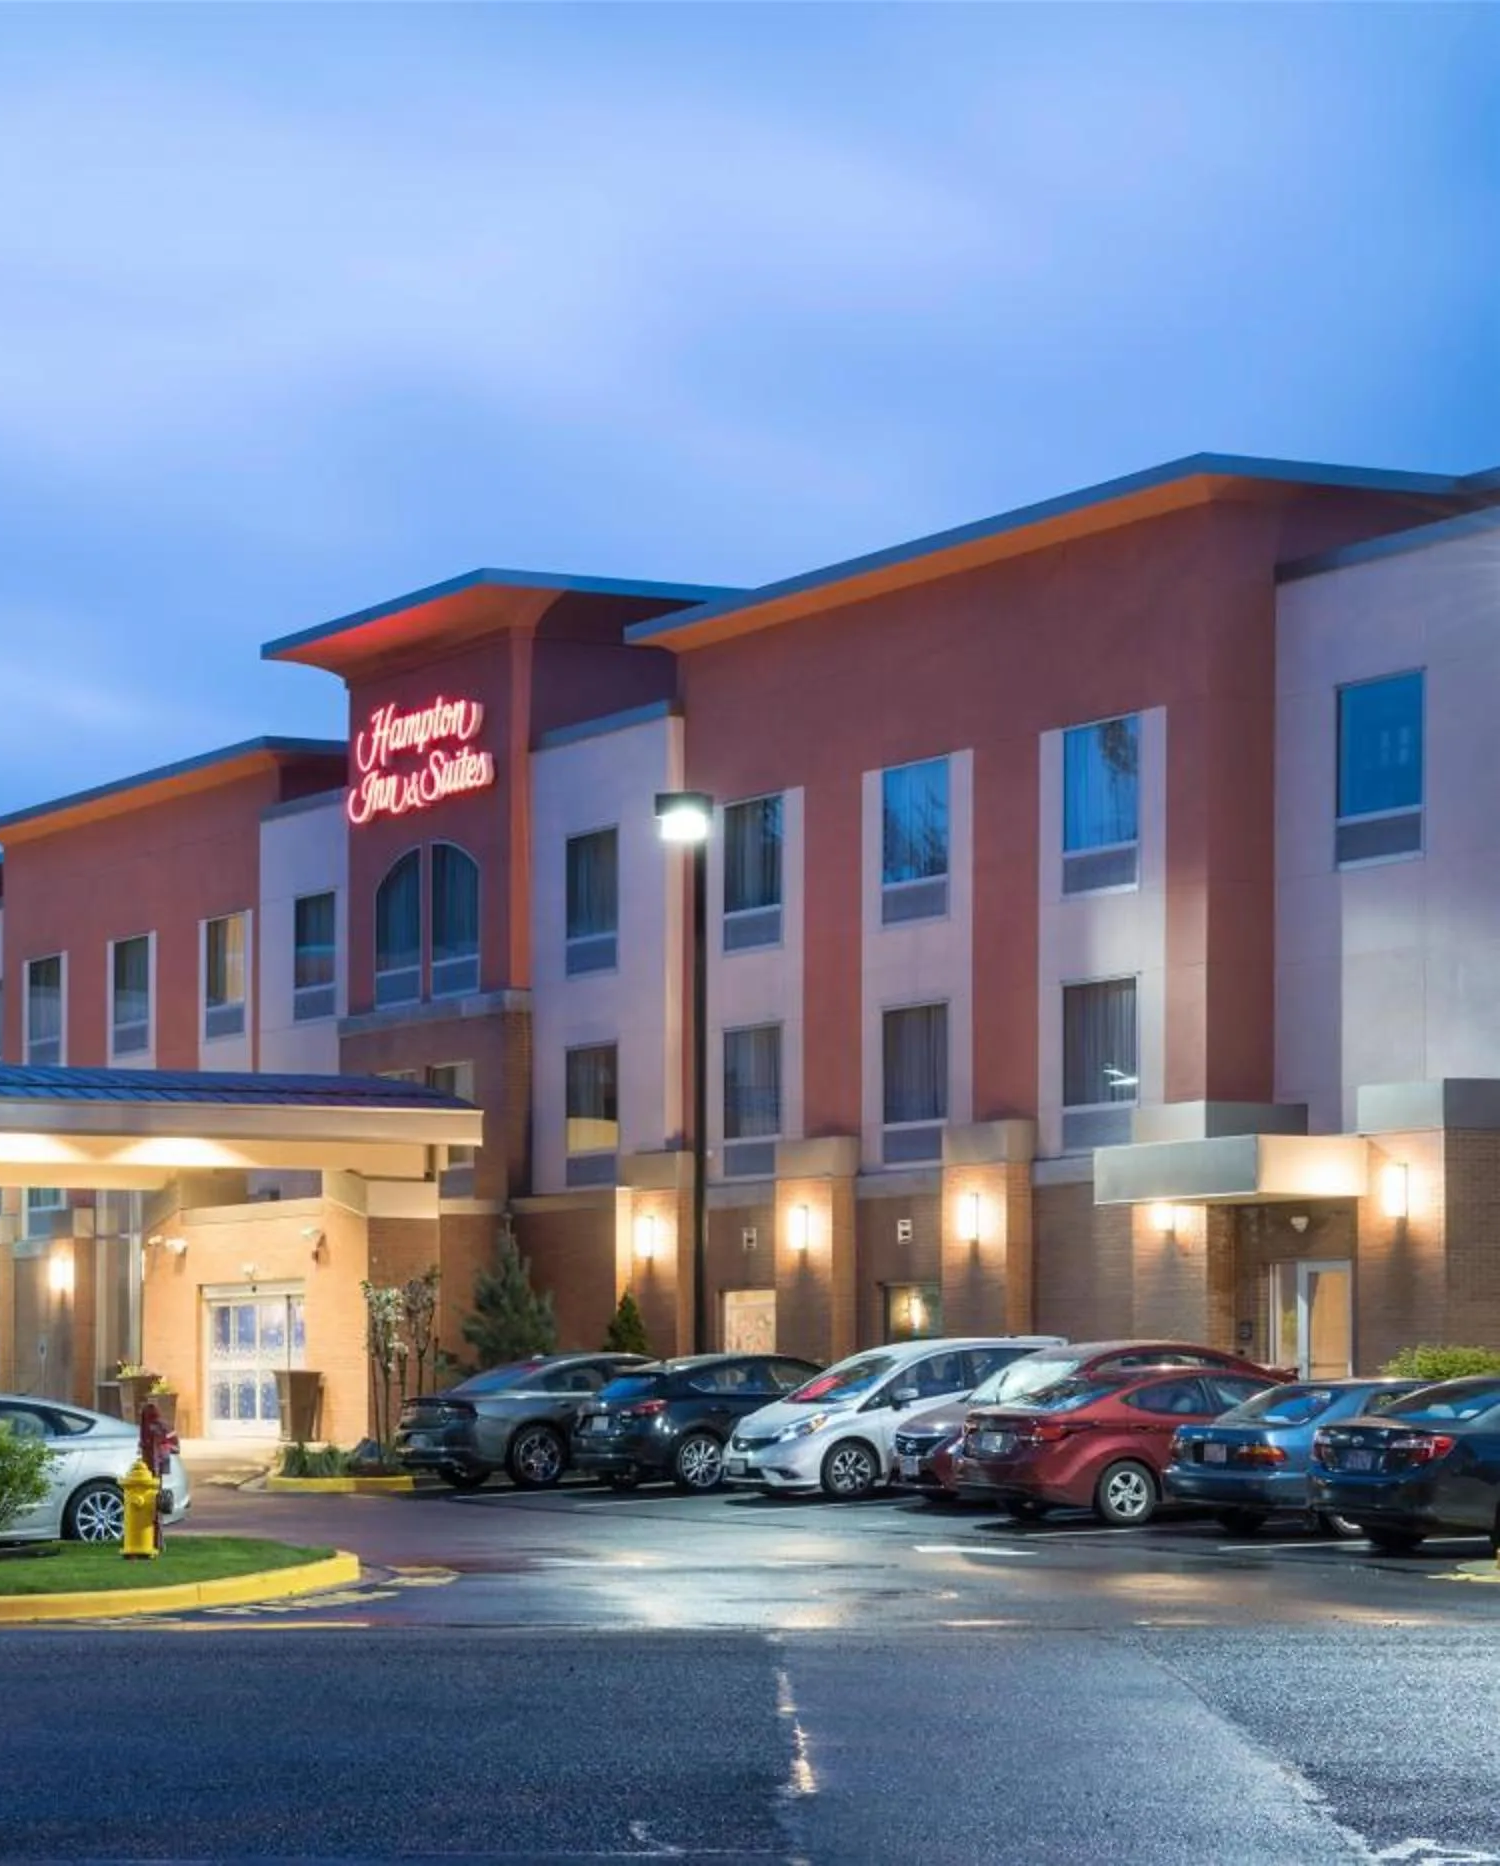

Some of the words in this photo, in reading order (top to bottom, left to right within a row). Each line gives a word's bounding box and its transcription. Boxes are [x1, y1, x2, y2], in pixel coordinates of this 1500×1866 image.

[357, 695, 483, 772] Hampton
[348, 770, 408, 823] Inn
[420, 745, 494, 802] Suites
